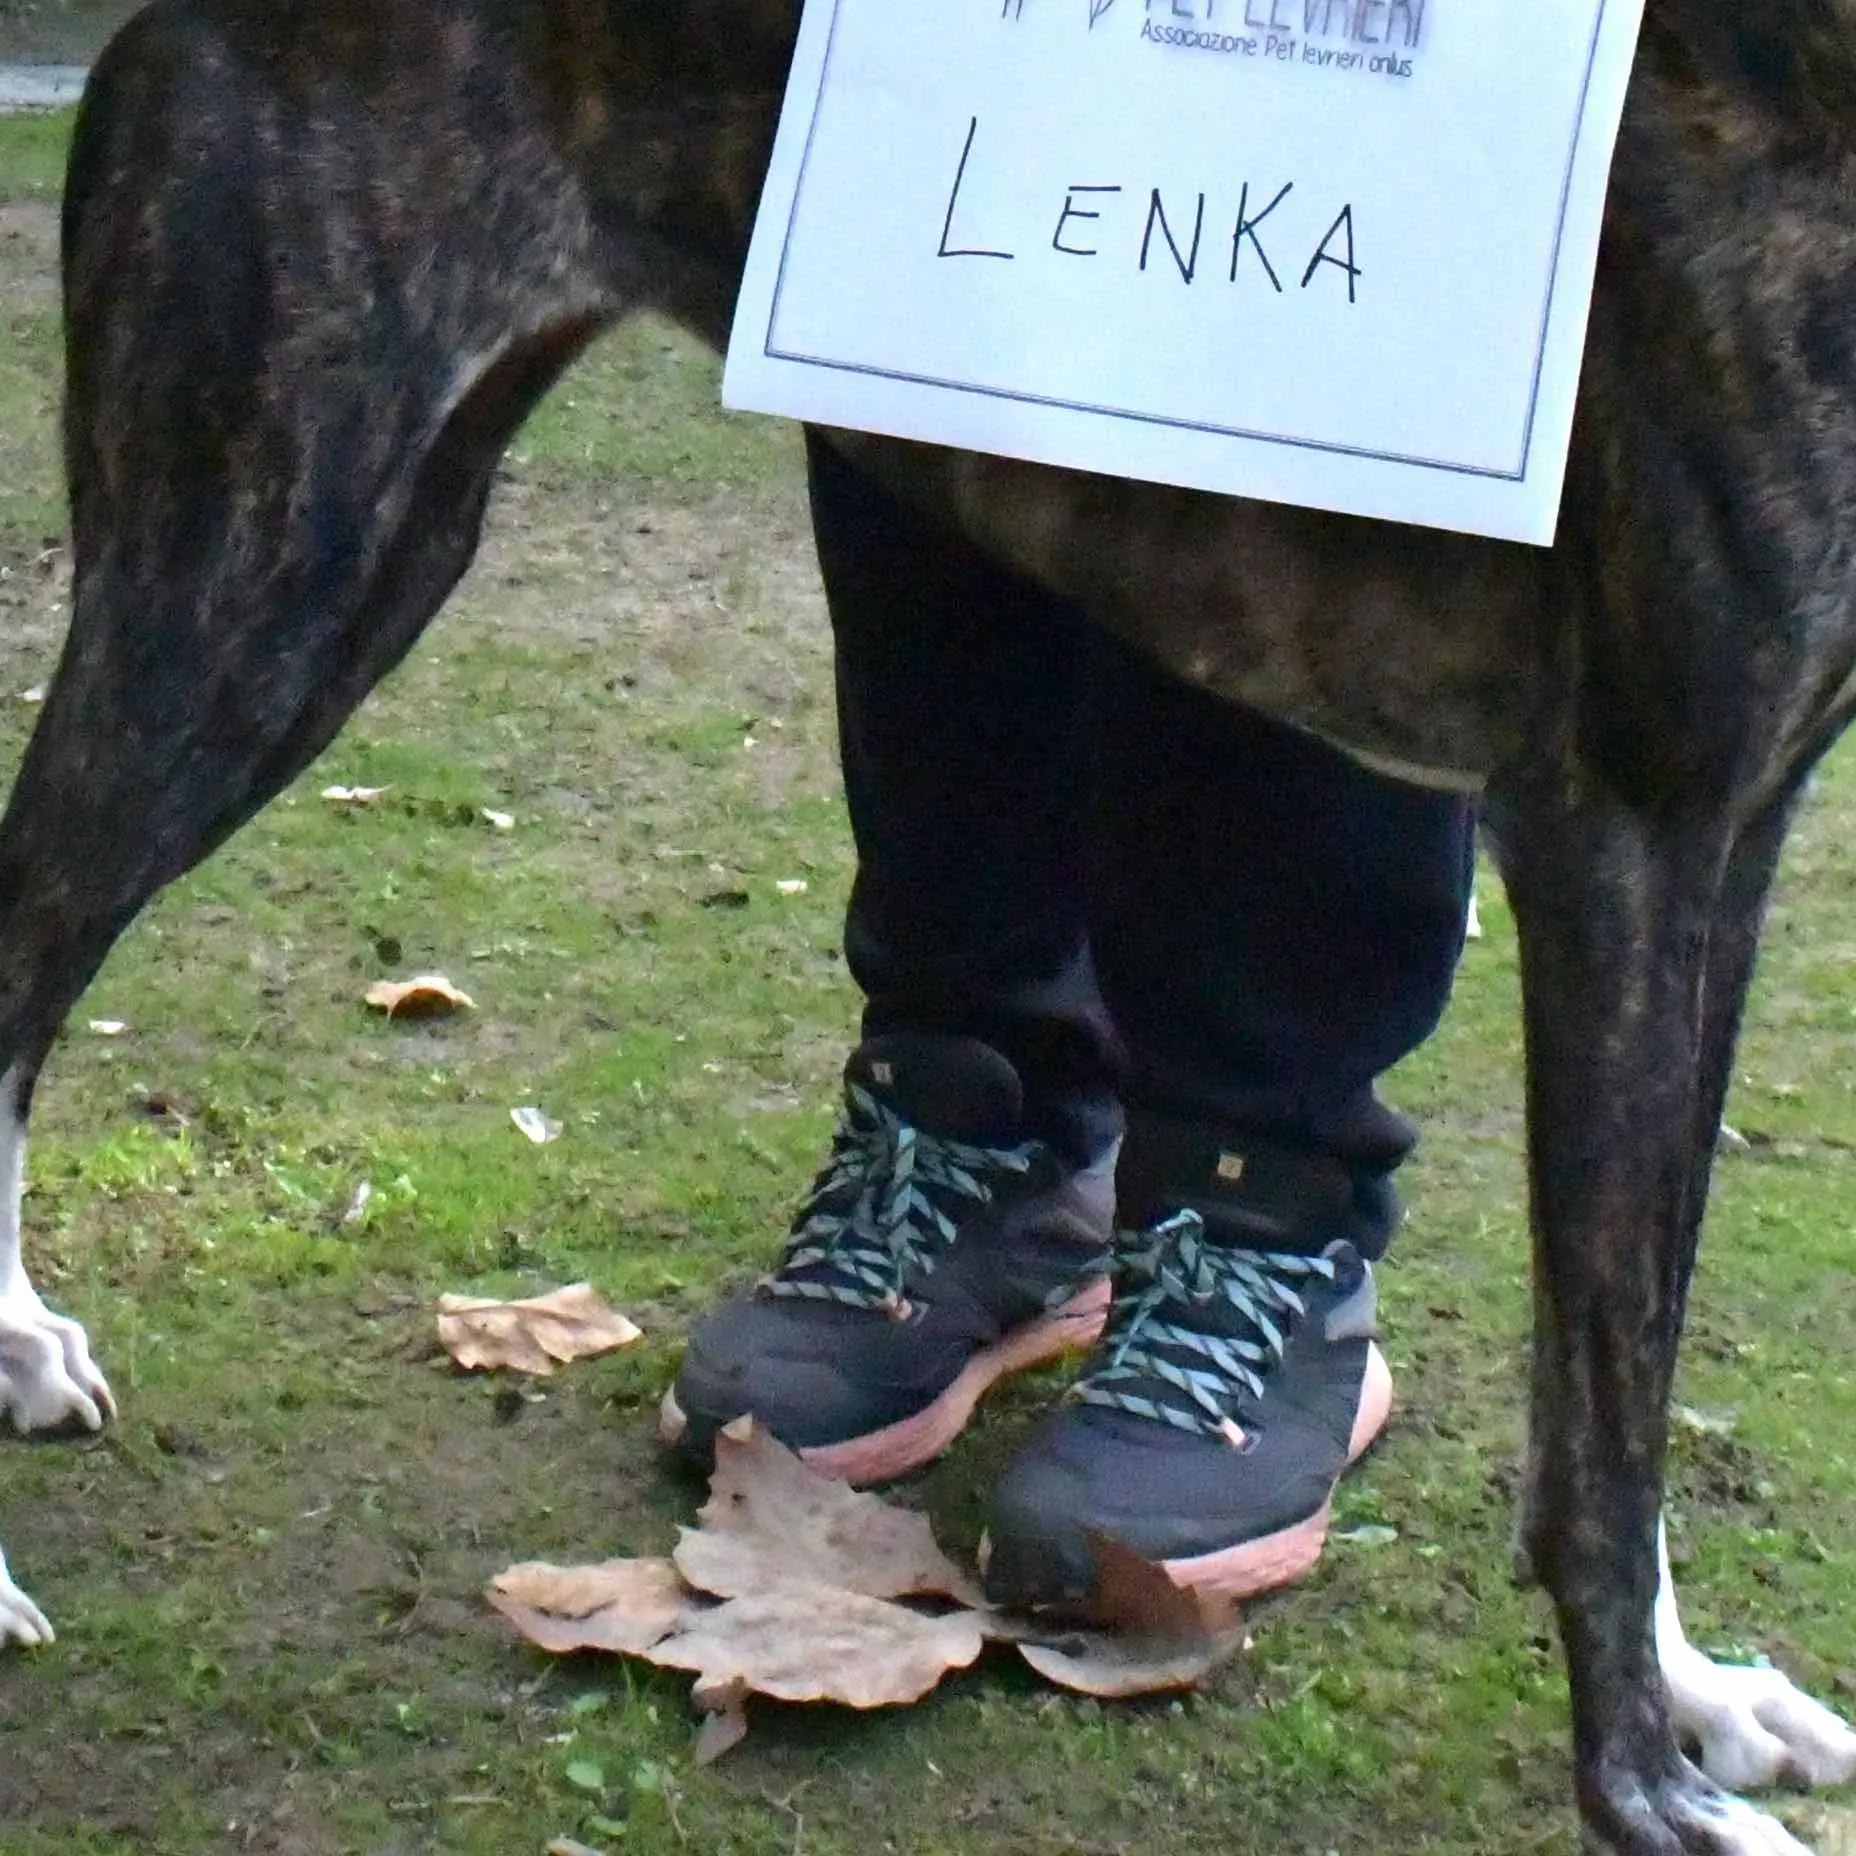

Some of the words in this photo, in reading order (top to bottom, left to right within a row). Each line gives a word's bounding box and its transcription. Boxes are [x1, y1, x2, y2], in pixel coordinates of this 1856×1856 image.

[1140, 17, 1257, 57] Associazione
[1264, 34, 1297, 62] Pet
[1301, 43, 1364, 71] levrieri
[1369, 52, 1414, 78] onlus
[937, 116, 1363, 304] LENKA
